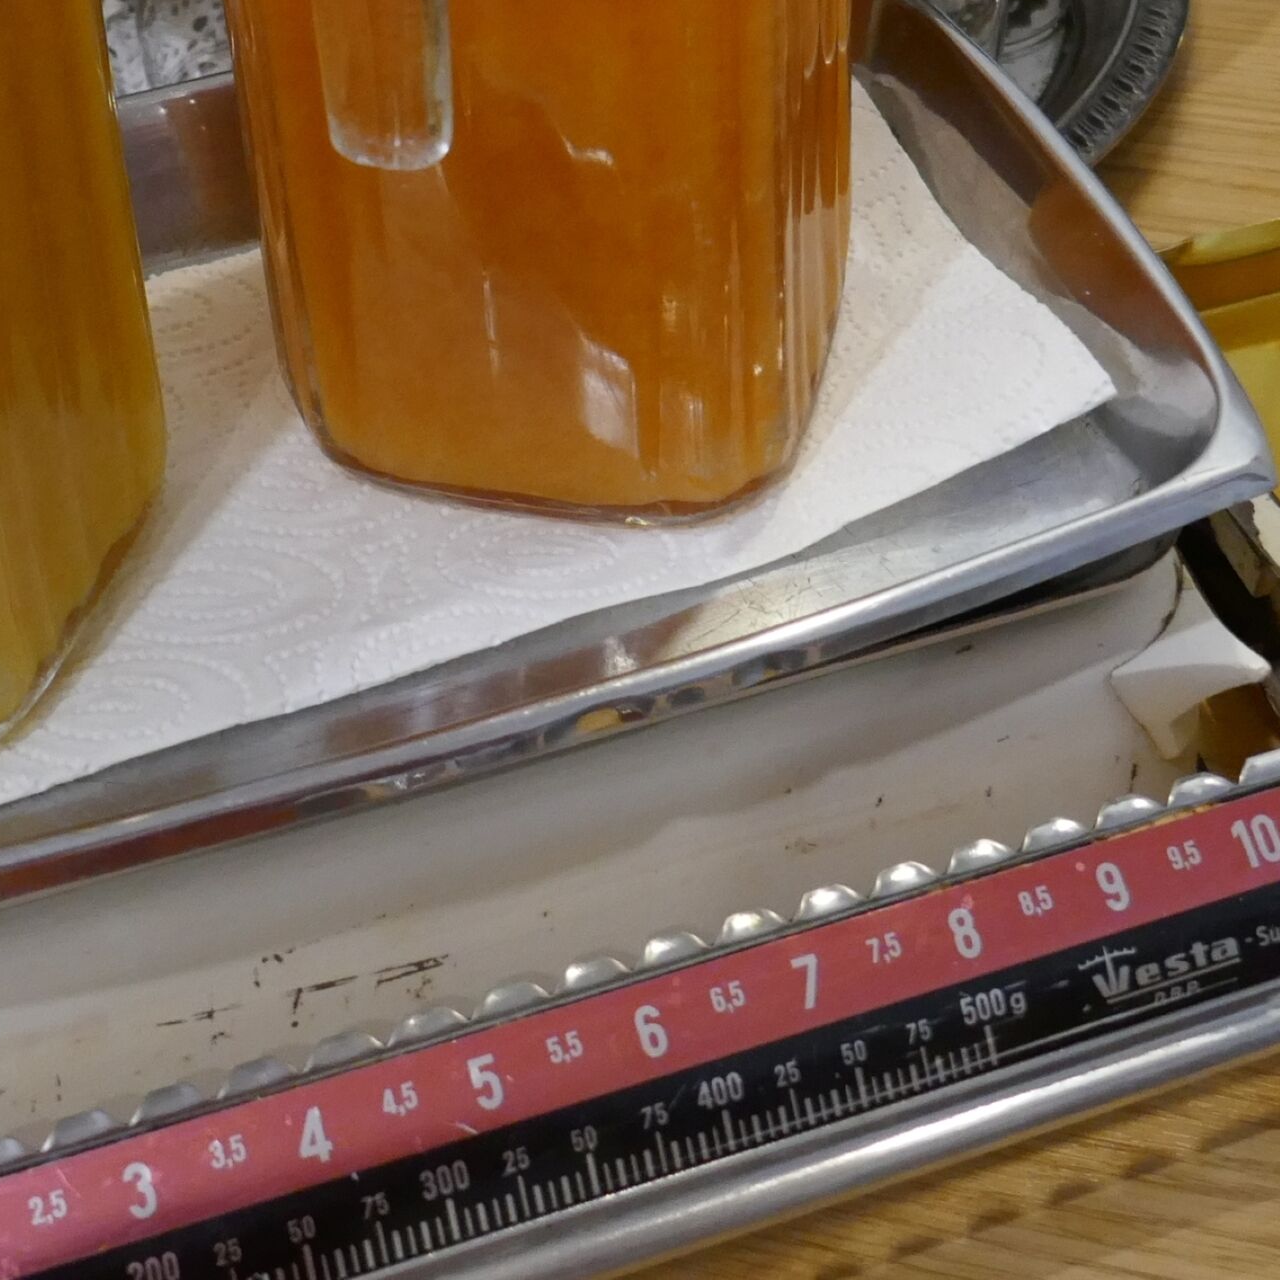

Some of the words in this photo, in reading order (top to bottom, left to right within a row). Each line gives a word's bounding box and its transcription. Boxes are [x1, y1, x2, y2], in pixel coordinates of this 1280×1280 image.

[28, 1189, 67, 1226] 2,5
[122, 1162, 156, 1217] 3
[208, 1134, 246, 1169] 3,5
[299, 1106, 333, 1161] 4
[382, 1081, 418, 1116] 4,5
[467, 1054, 503, 1109] 5
[545, 1030, 583, 1064] 5,5
[634, 1004, 668, 1058] 6
[709, 980, 746, 1013] 6,5
[790, 953, 818, 1009] 7
[865, 931, 902, 964] 7,5
[947, 908, 982, 959] 8
[1018, 885, 1053, 916] 8,5
[1096, 862, 1130, 912] 9
[1166, 839, 1202, 870] 9,5
[213, 1237, 242, 1267] 25
[287, 1215, 316, 1243] 50
[362, 1192, 389, 1219] 75
[420, 1160, 470, 1200] 300
[503, 1146, 530, 1173] 25
[570, 1125, 598, 1154] 50
[640, 1101, 669, 1129] 75
[698, 1071, 742, 1107] 400
[774, 1059, 800, 1087] 25
[840, 1039, 867, 1065] 50
[905, 1018, 931, 1043] 75
